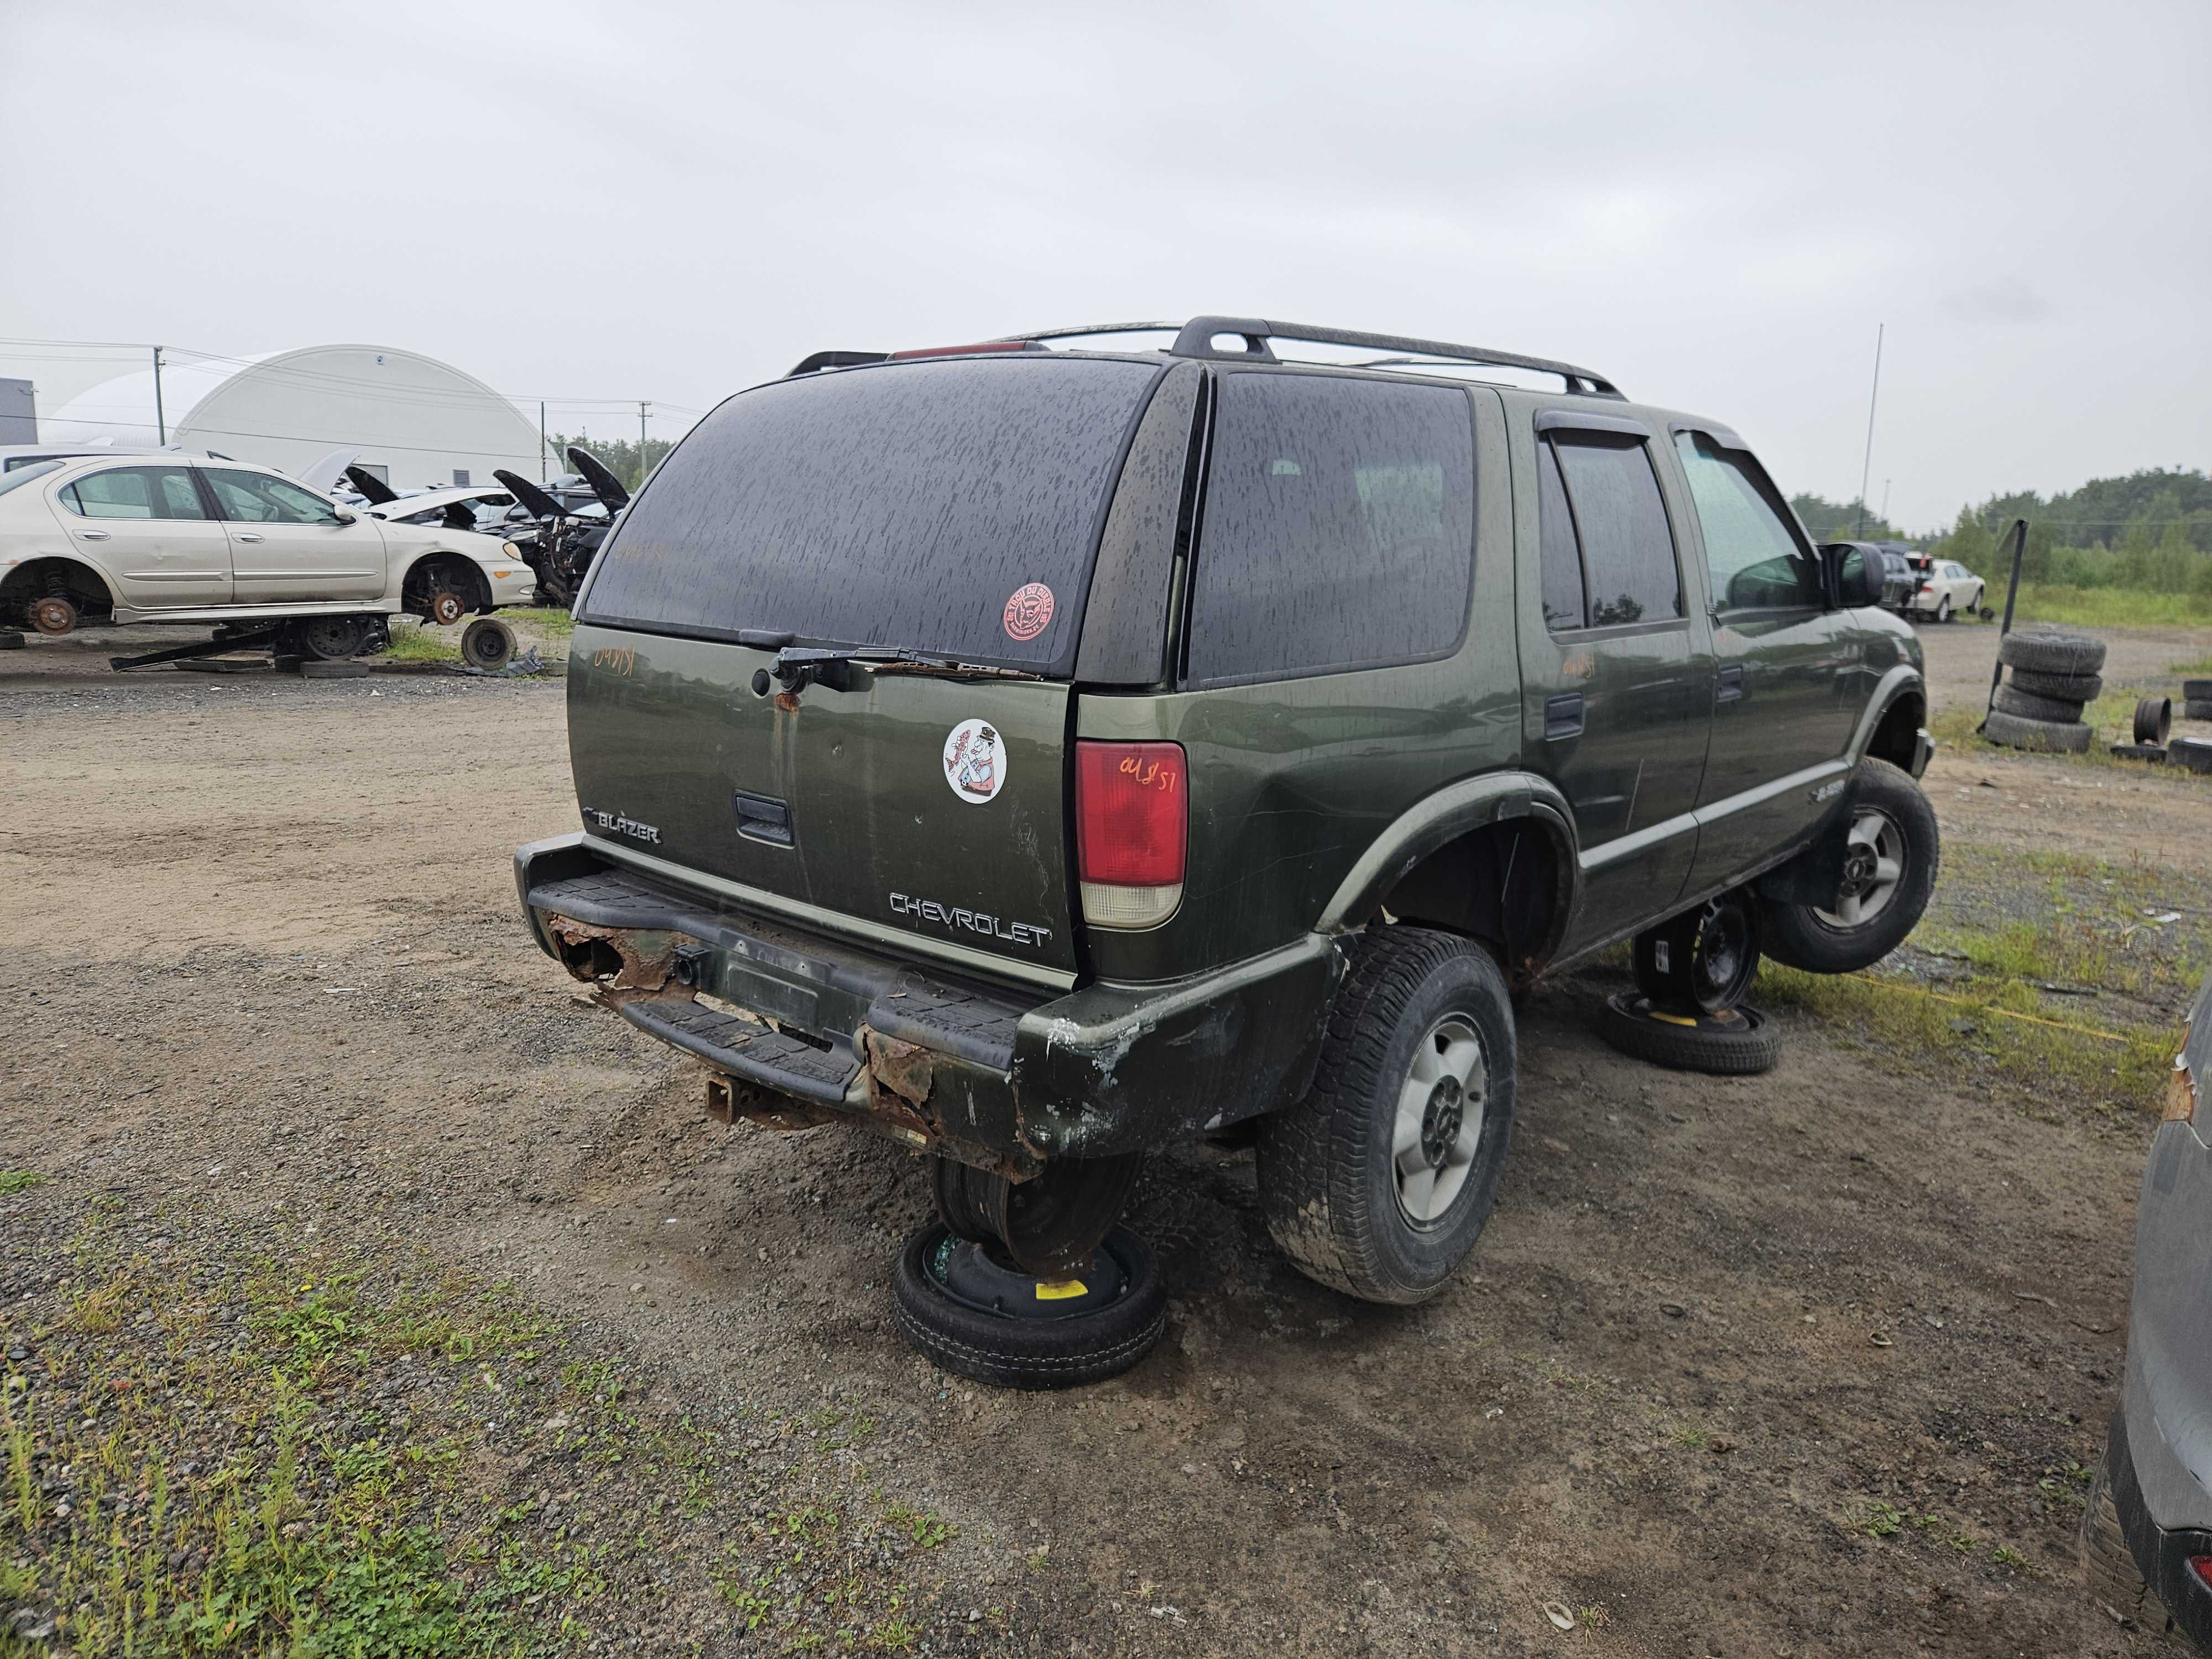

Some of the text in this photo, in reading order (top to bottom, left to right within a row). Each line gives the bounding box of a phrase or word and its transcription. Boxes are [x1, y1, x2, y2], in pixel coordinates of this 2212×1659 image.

[1027, 586, 1037, 595] DU
[1037, 587, 1051, 613] DIABLE
[599, 811, 661, 844] BLAZER
[889, 892, 1051, 947] CHEVROLET
